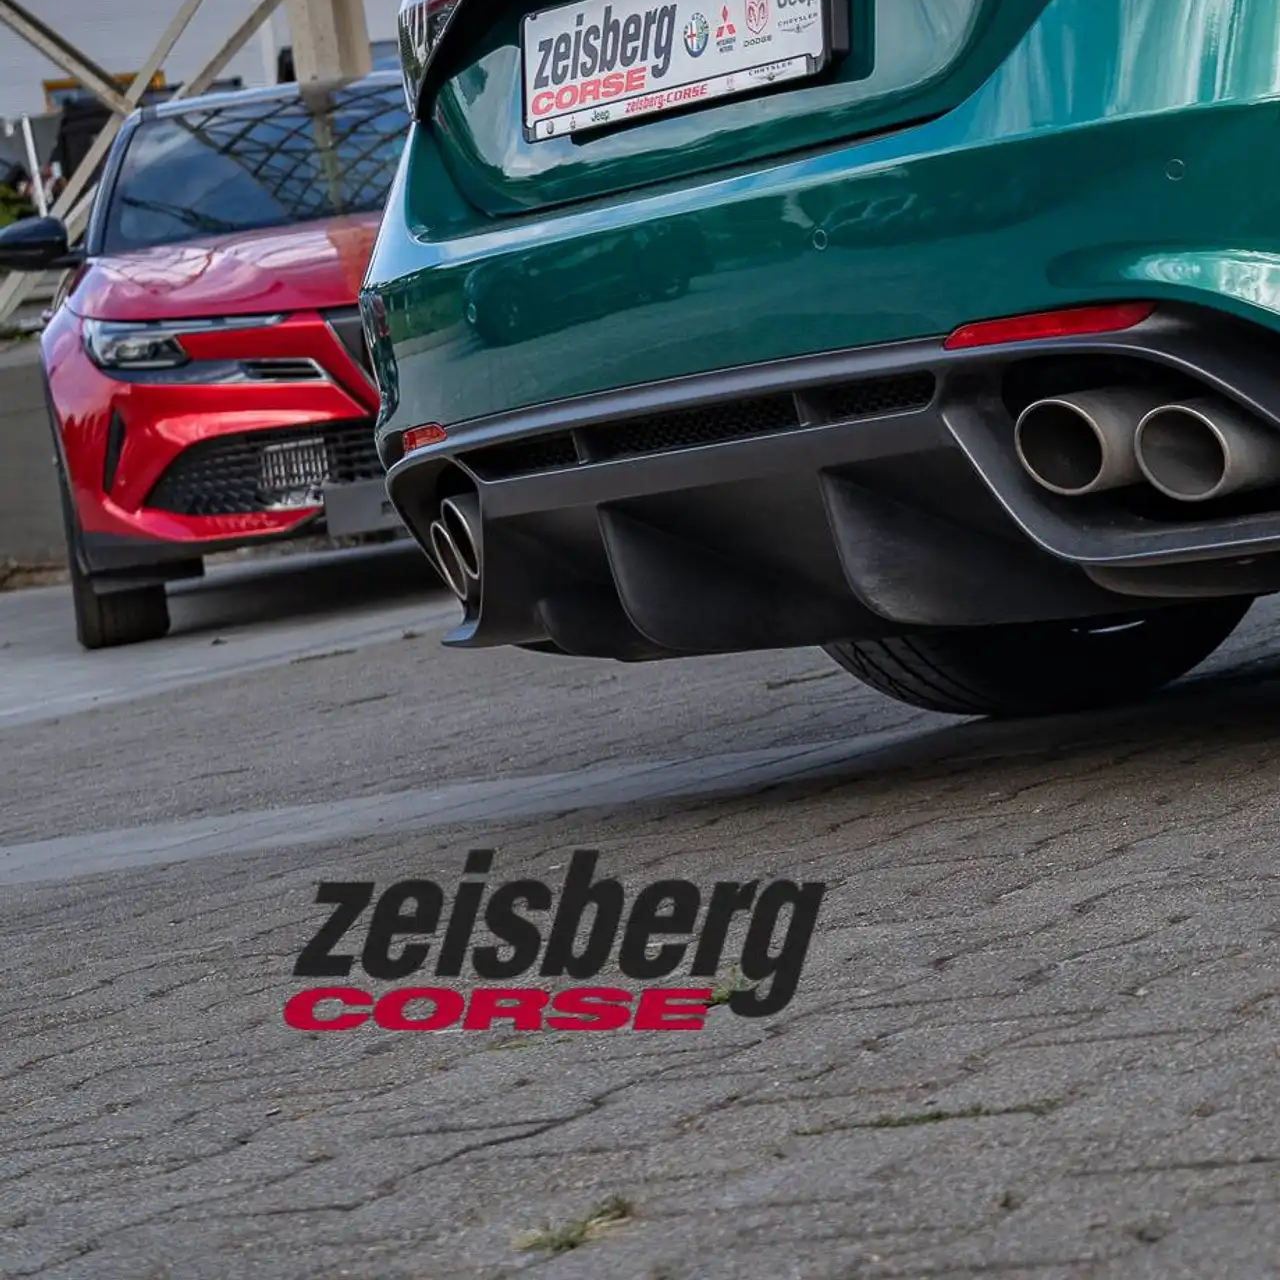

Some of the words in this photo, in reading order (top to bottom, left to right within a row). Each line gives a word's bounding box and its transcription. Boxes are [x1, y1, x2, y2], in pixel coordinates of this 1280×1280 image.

[533, 3, 677, 89] zeisberg
[743, 35, 773, 47] DODGE
[531, 66, 647, 115] CORSE
[591, 108, 611, 123] Jeep
